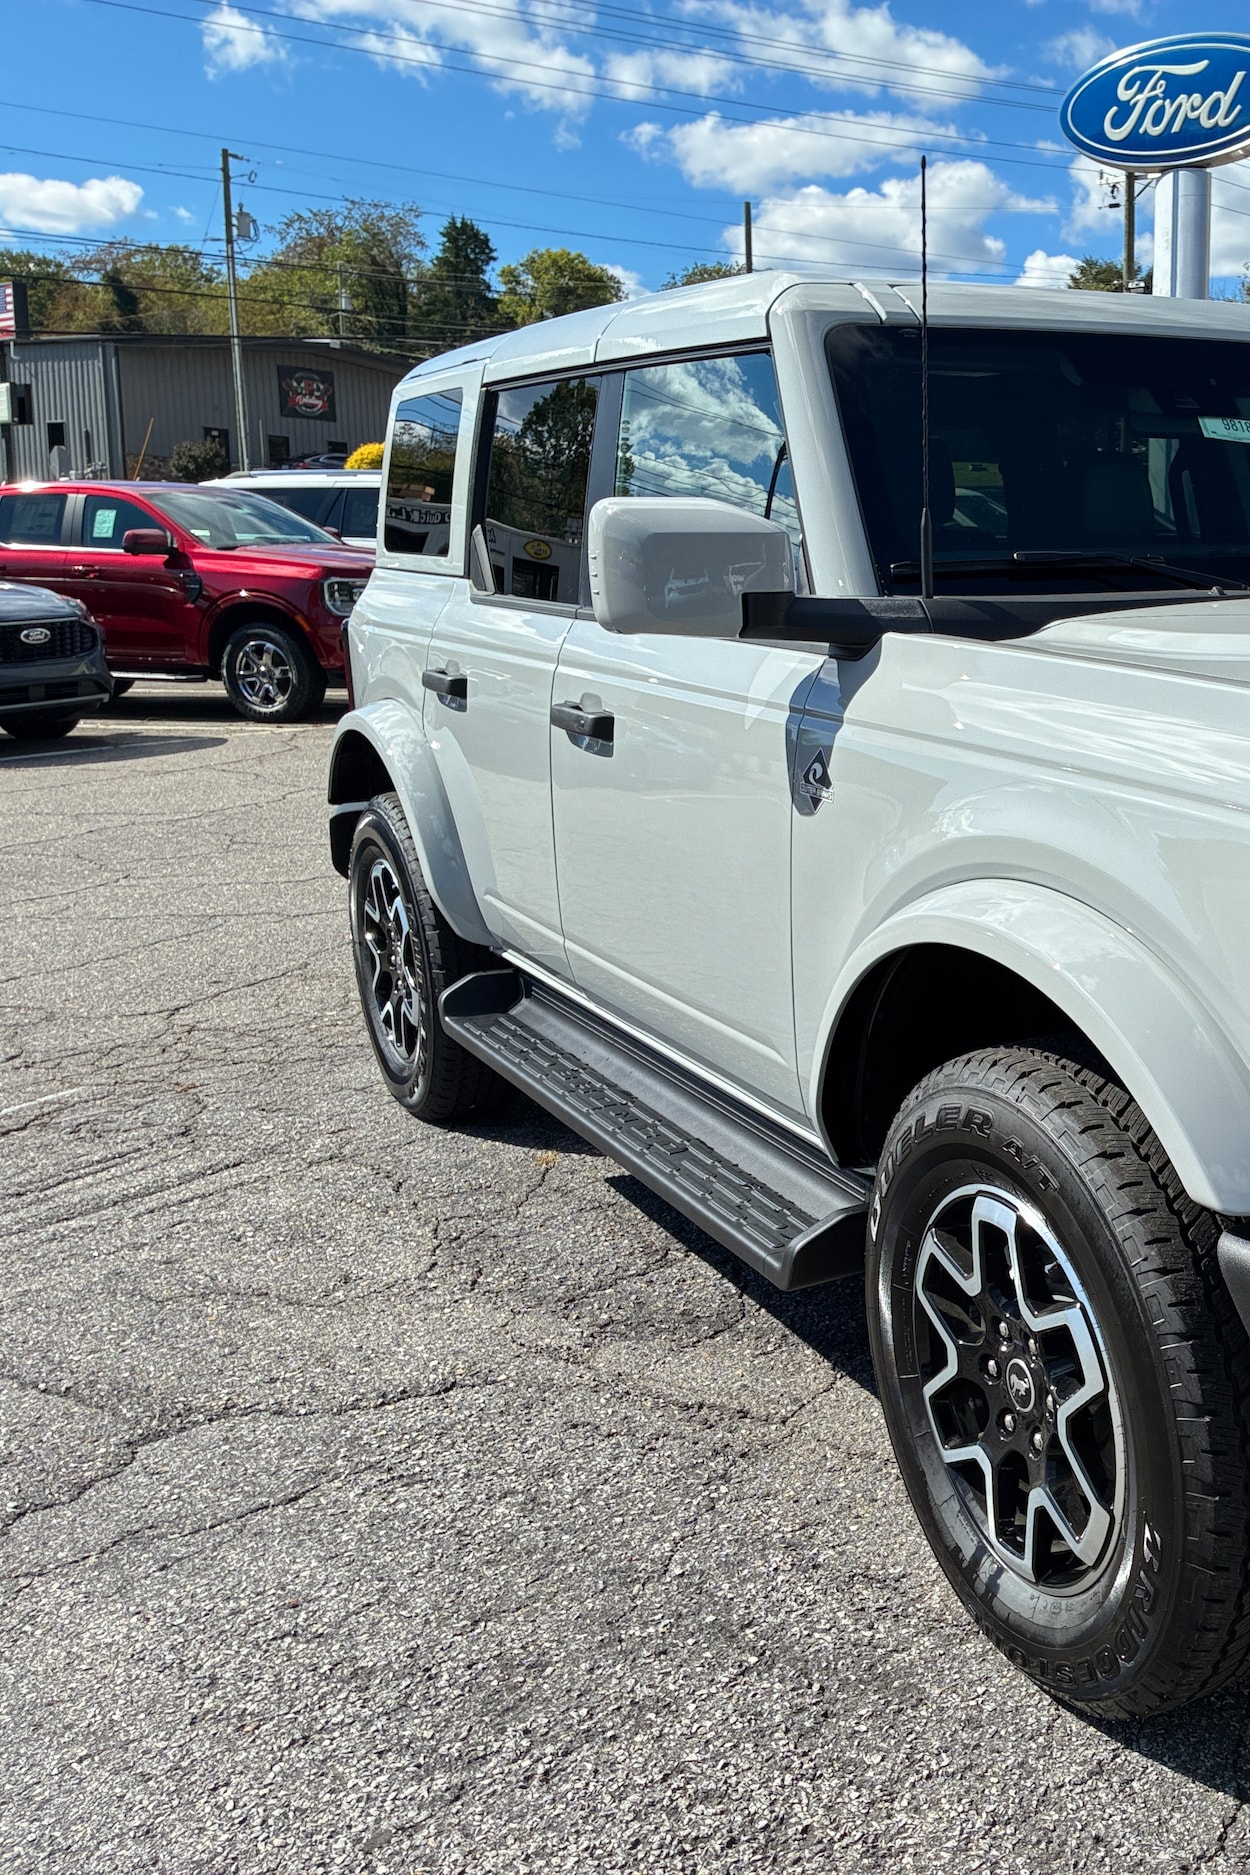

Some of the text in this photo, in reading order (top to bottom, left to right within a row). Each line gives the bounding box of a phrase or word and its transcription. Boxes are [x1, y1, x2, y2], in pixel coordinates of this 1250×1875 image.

[1103, 59, 1247, 142] Ford
[870, 1102, 1061, 1243] DUELER A/T
